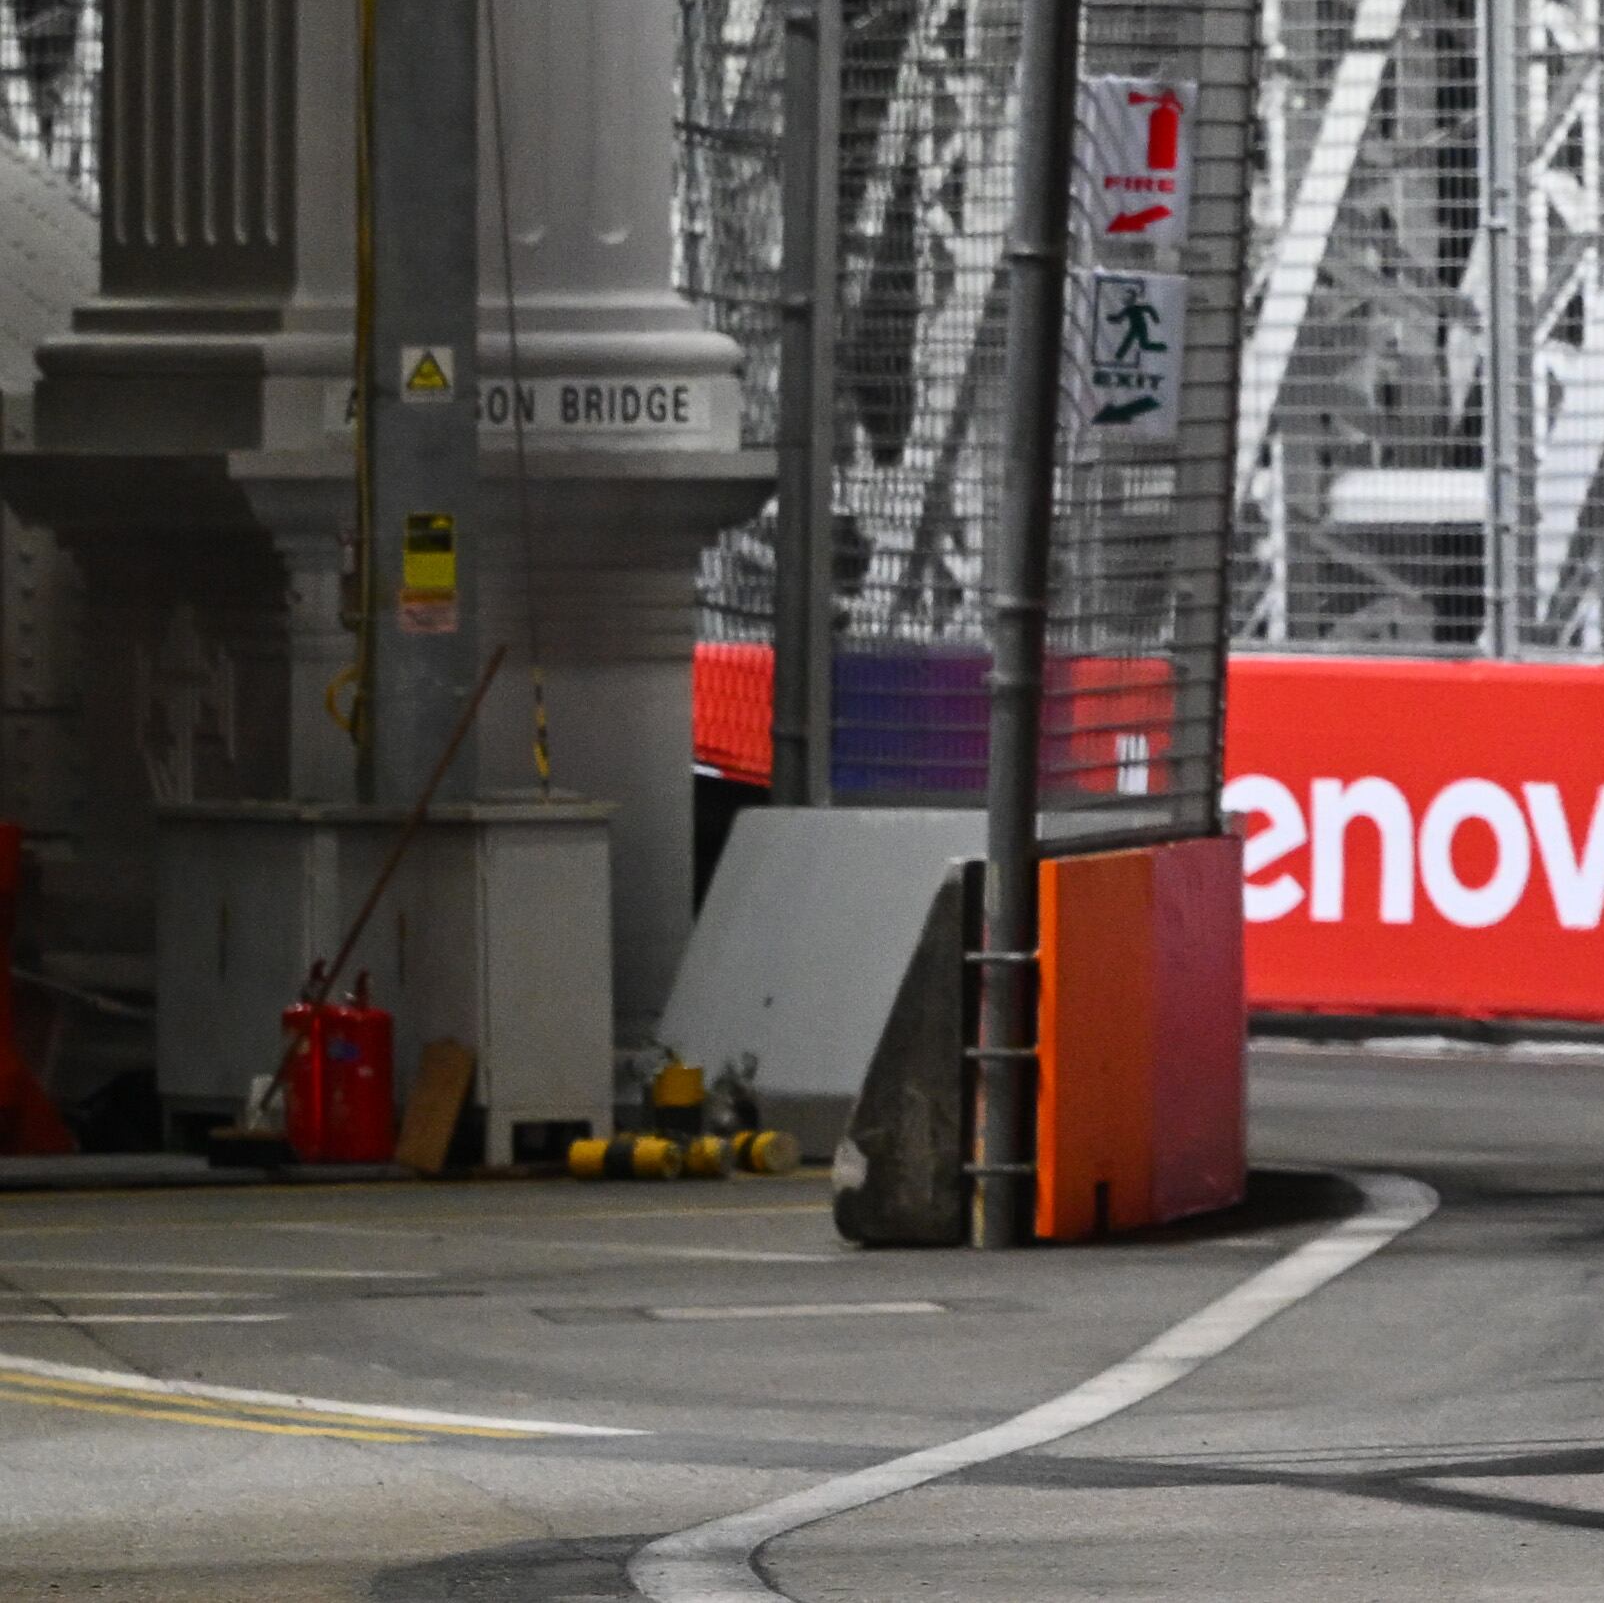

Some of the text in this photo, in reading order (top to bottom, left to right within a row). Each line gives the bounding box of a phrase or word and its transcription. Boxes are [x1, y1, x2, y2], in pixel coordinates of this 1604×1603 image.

[1103, 175, 1176, 193] FIRE
[1092, 370, 1165, 391] EXIT
[560, 385, 691, 424] BRIDGE
